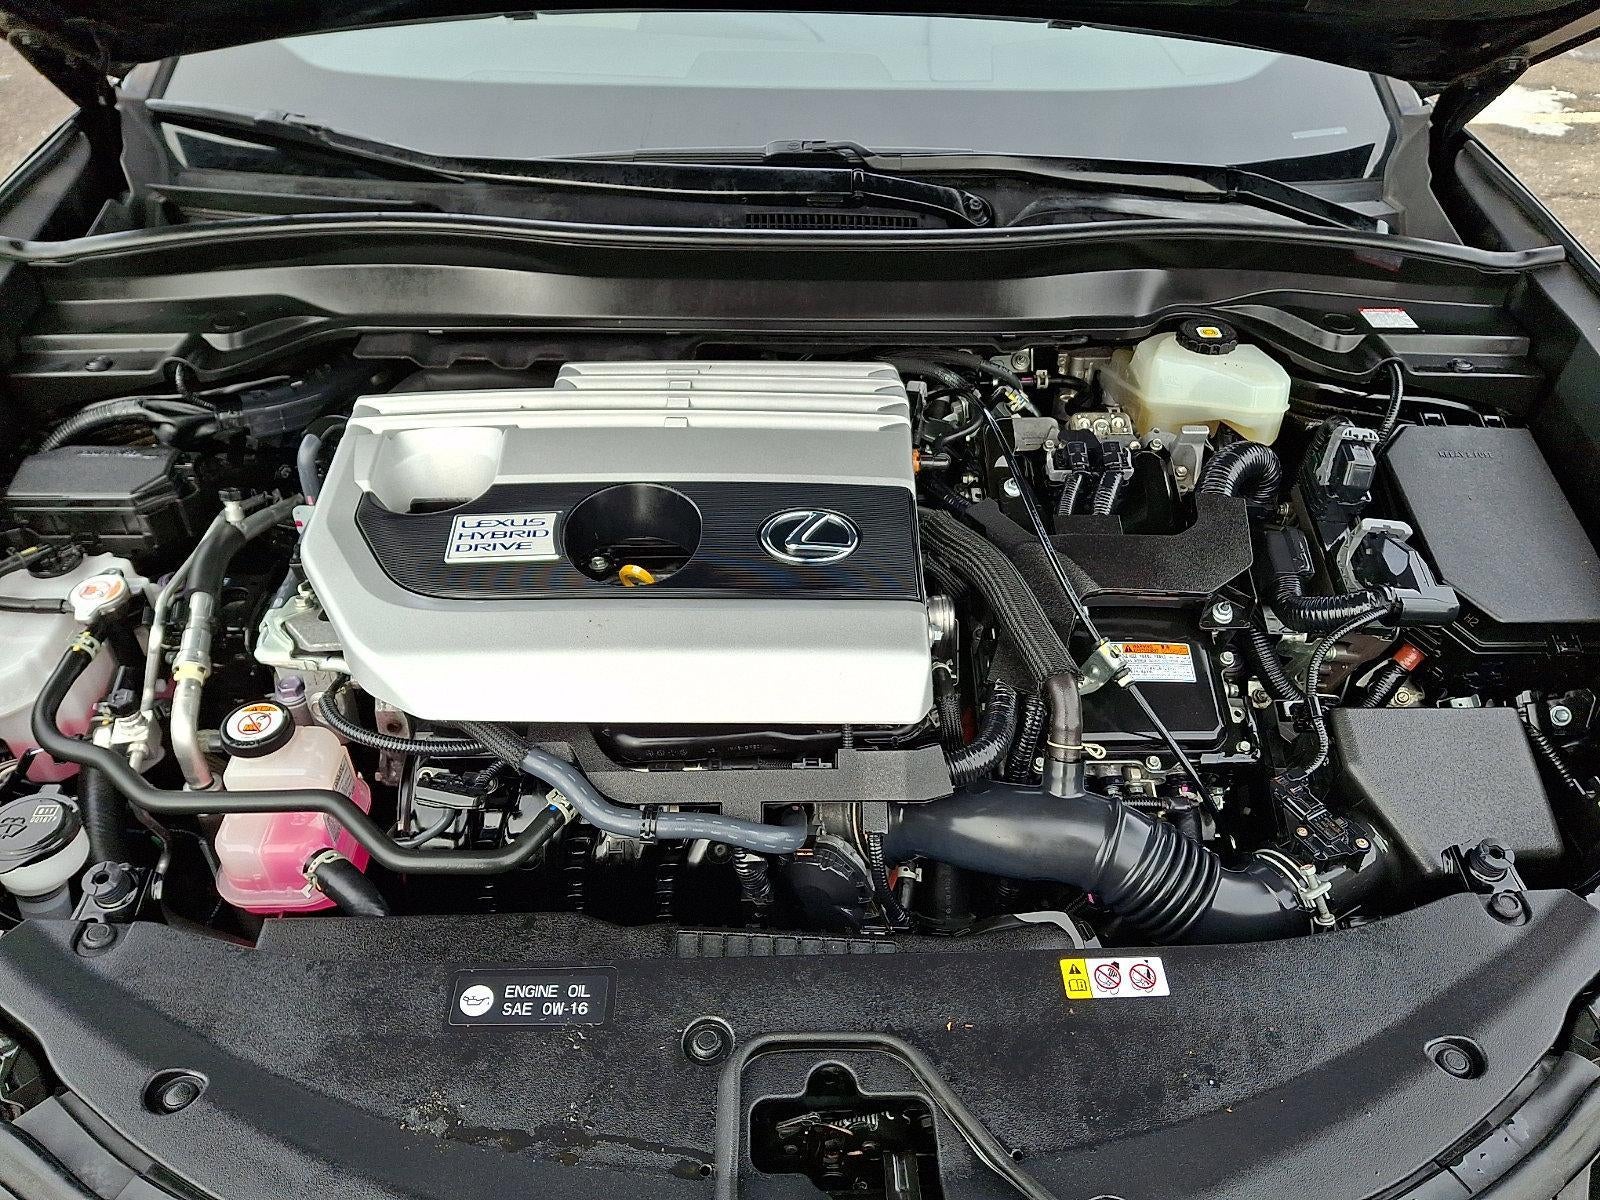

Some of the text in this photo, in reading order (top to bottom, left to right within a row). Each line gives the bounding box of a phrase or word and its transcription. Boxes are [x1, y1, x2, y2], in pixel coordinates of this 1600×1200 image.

[461, 517, 546, 529] LEXUS
[457, 529, 550, 541] HYBRID
[454, 541, 533, 552] DRIVE
[504, 984, 591, 998] ENGINE OIL
[501, 1001, 589, 1016] SAE 0W-16
